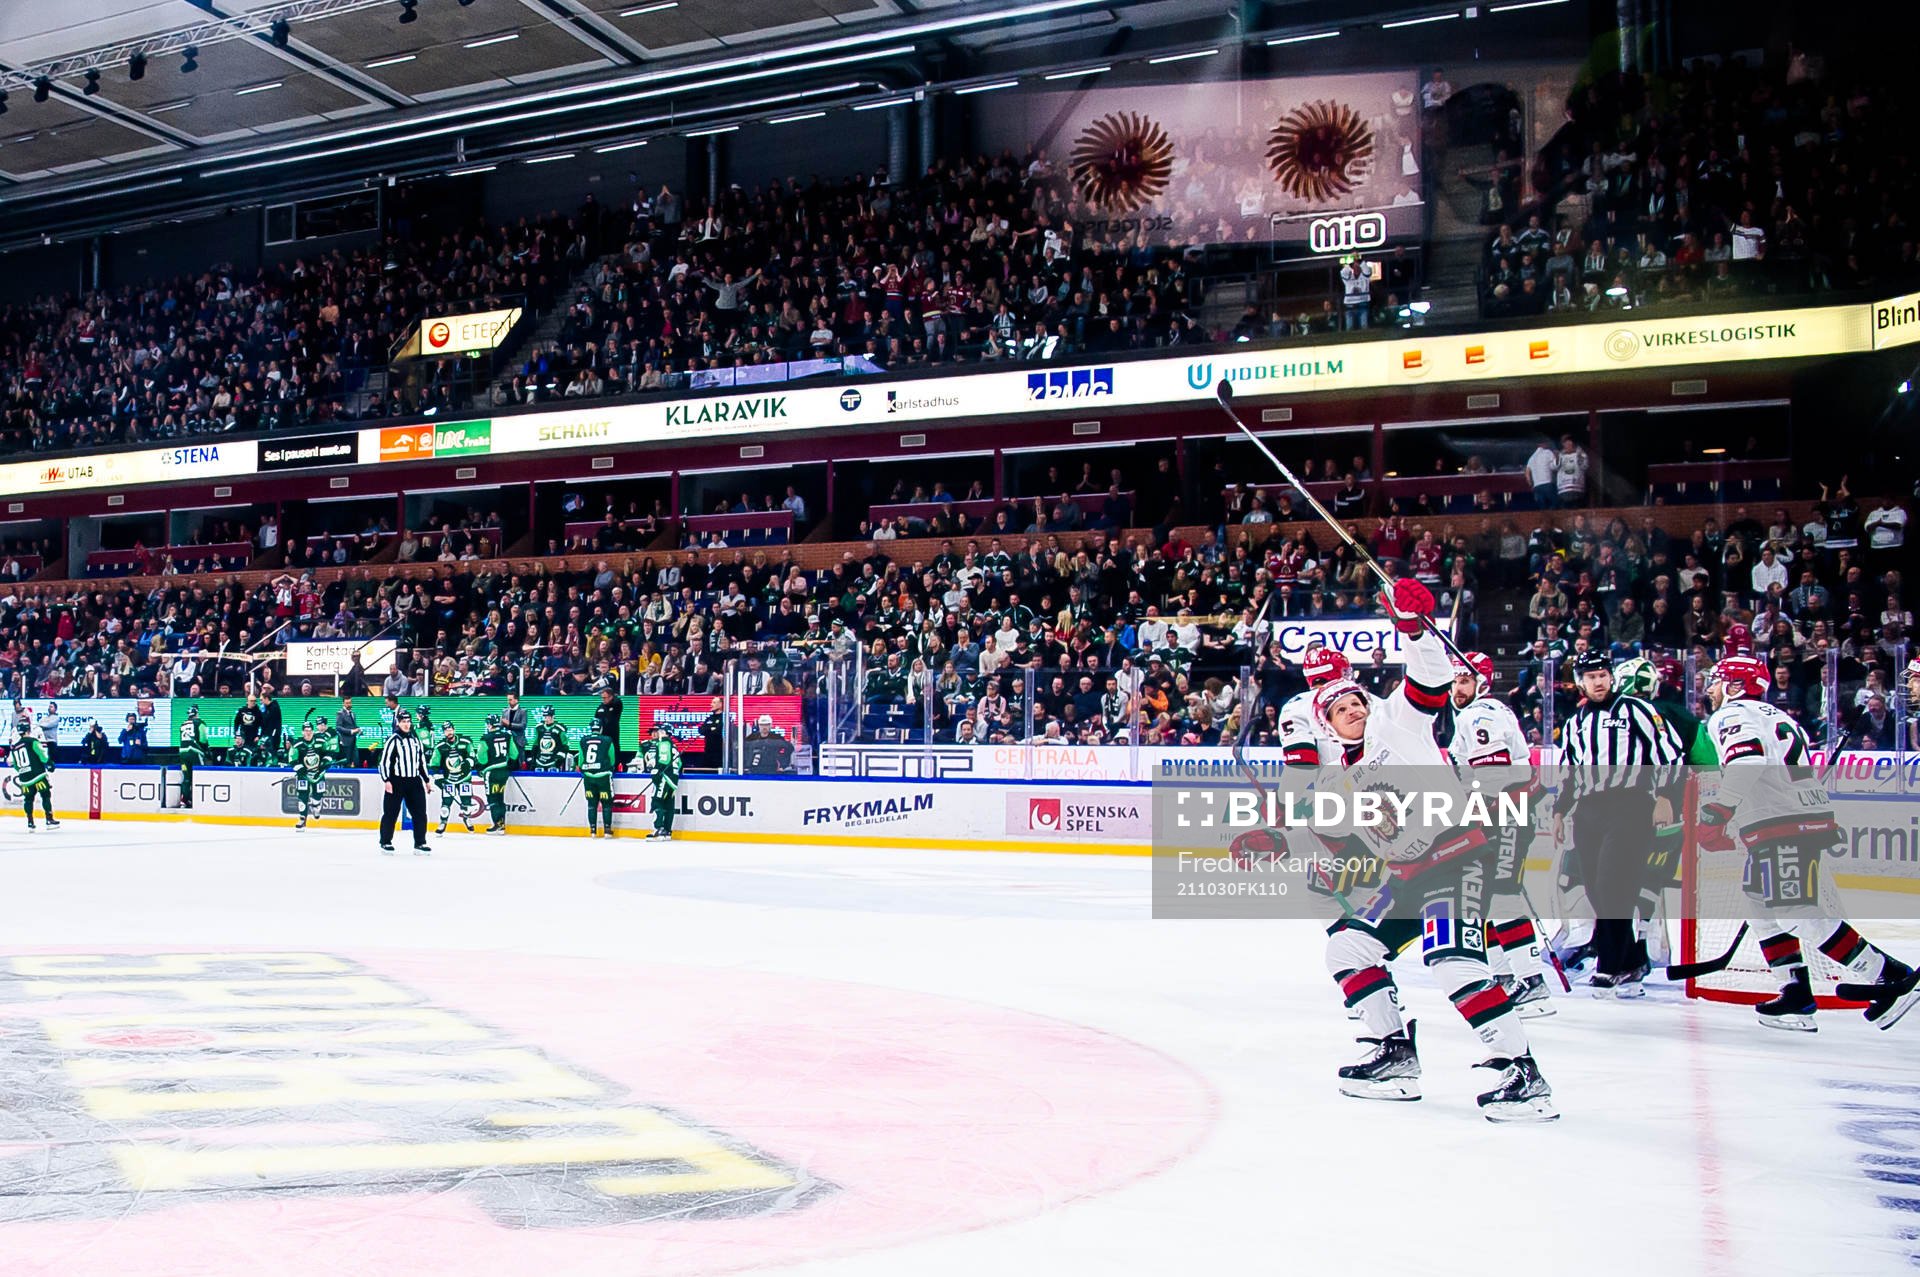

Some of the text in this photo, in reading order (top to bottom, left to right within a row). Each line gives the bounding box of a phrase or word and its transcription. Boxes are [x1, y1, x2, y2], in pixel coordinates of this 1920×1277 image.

[1643, 323, 1796, 348] VIRKESLOGISTIK
[1224, 359, 1343, 383] UDDEHOLM
[666, 396, 787, 426] KLARAVIK
[174, 446, 219, 465] STENA
[68, 465, 94, 479] UTAB
[306, 659, 343, 673] Energi
[1282, 720, 1295, 737] 5
[1603, 718, 1626, 728] SHL
[1476, 728, 1490, 745] 9
[13, 747, 30, 767] 10
[586, 744, 598, 763] 6
[994, 749, 1099, 765] CENTRALA
[698, 796, 754, 817] OUT.
[803, 793, 934, 826] FRYKMALM
[1066, 805, 1139, 819] SVENSKA
[1066, 820, 1104, 832] SPEL
